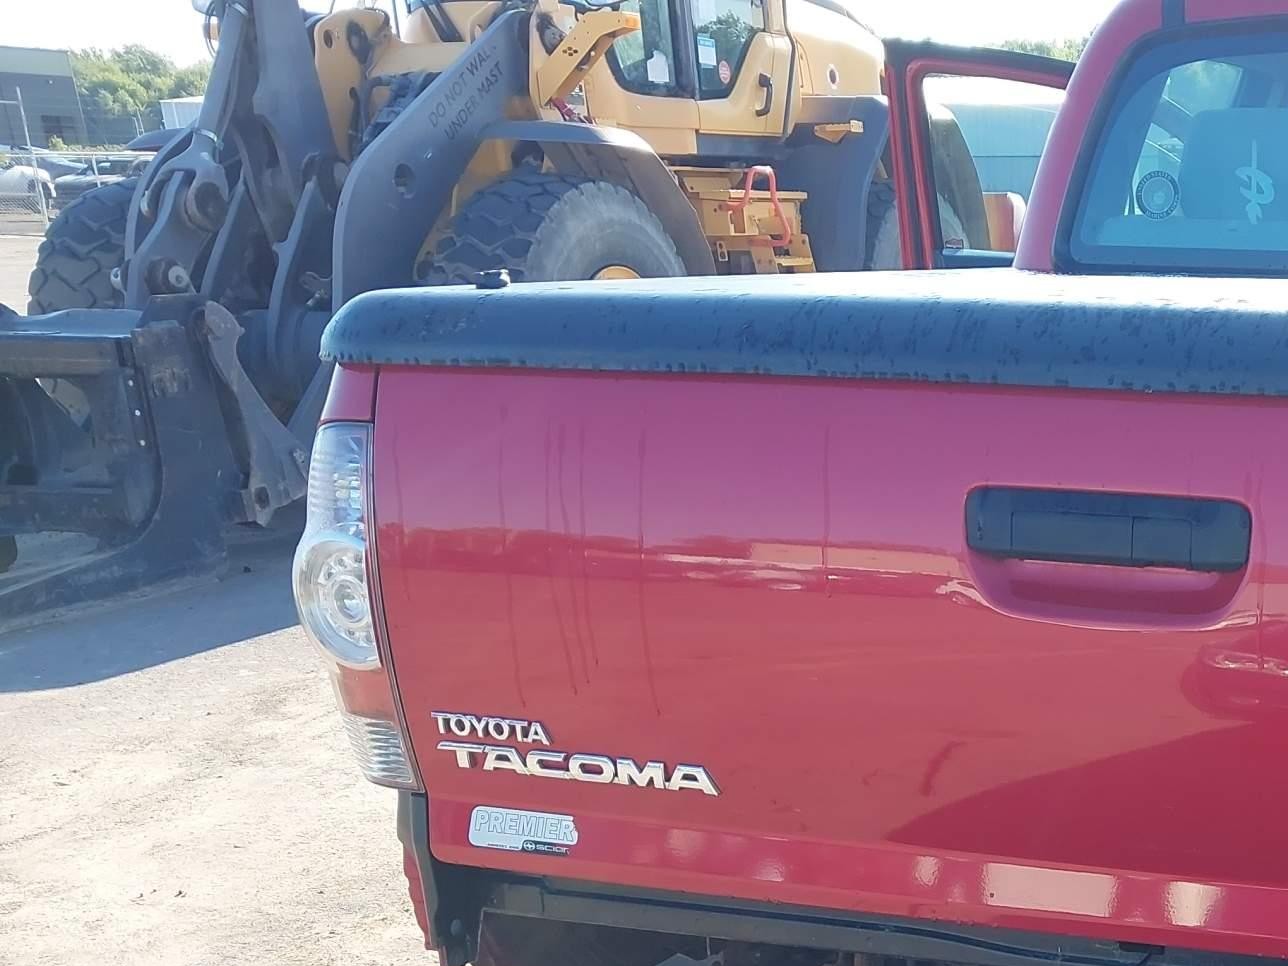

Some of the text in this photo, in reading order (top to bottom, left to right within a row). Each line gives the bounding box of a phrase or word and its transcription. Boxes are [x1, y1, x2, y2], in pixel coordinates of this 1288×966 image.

[477, 61, 504, 99] MAST
[428, 102, 446, 128] DO
[444, 71, 467, 107] NOT
[431, 711, 552, 745] TOYOTA
[437, 741, 722, 797] TACOMA
[474, 809, 574, 842] PREMIER
